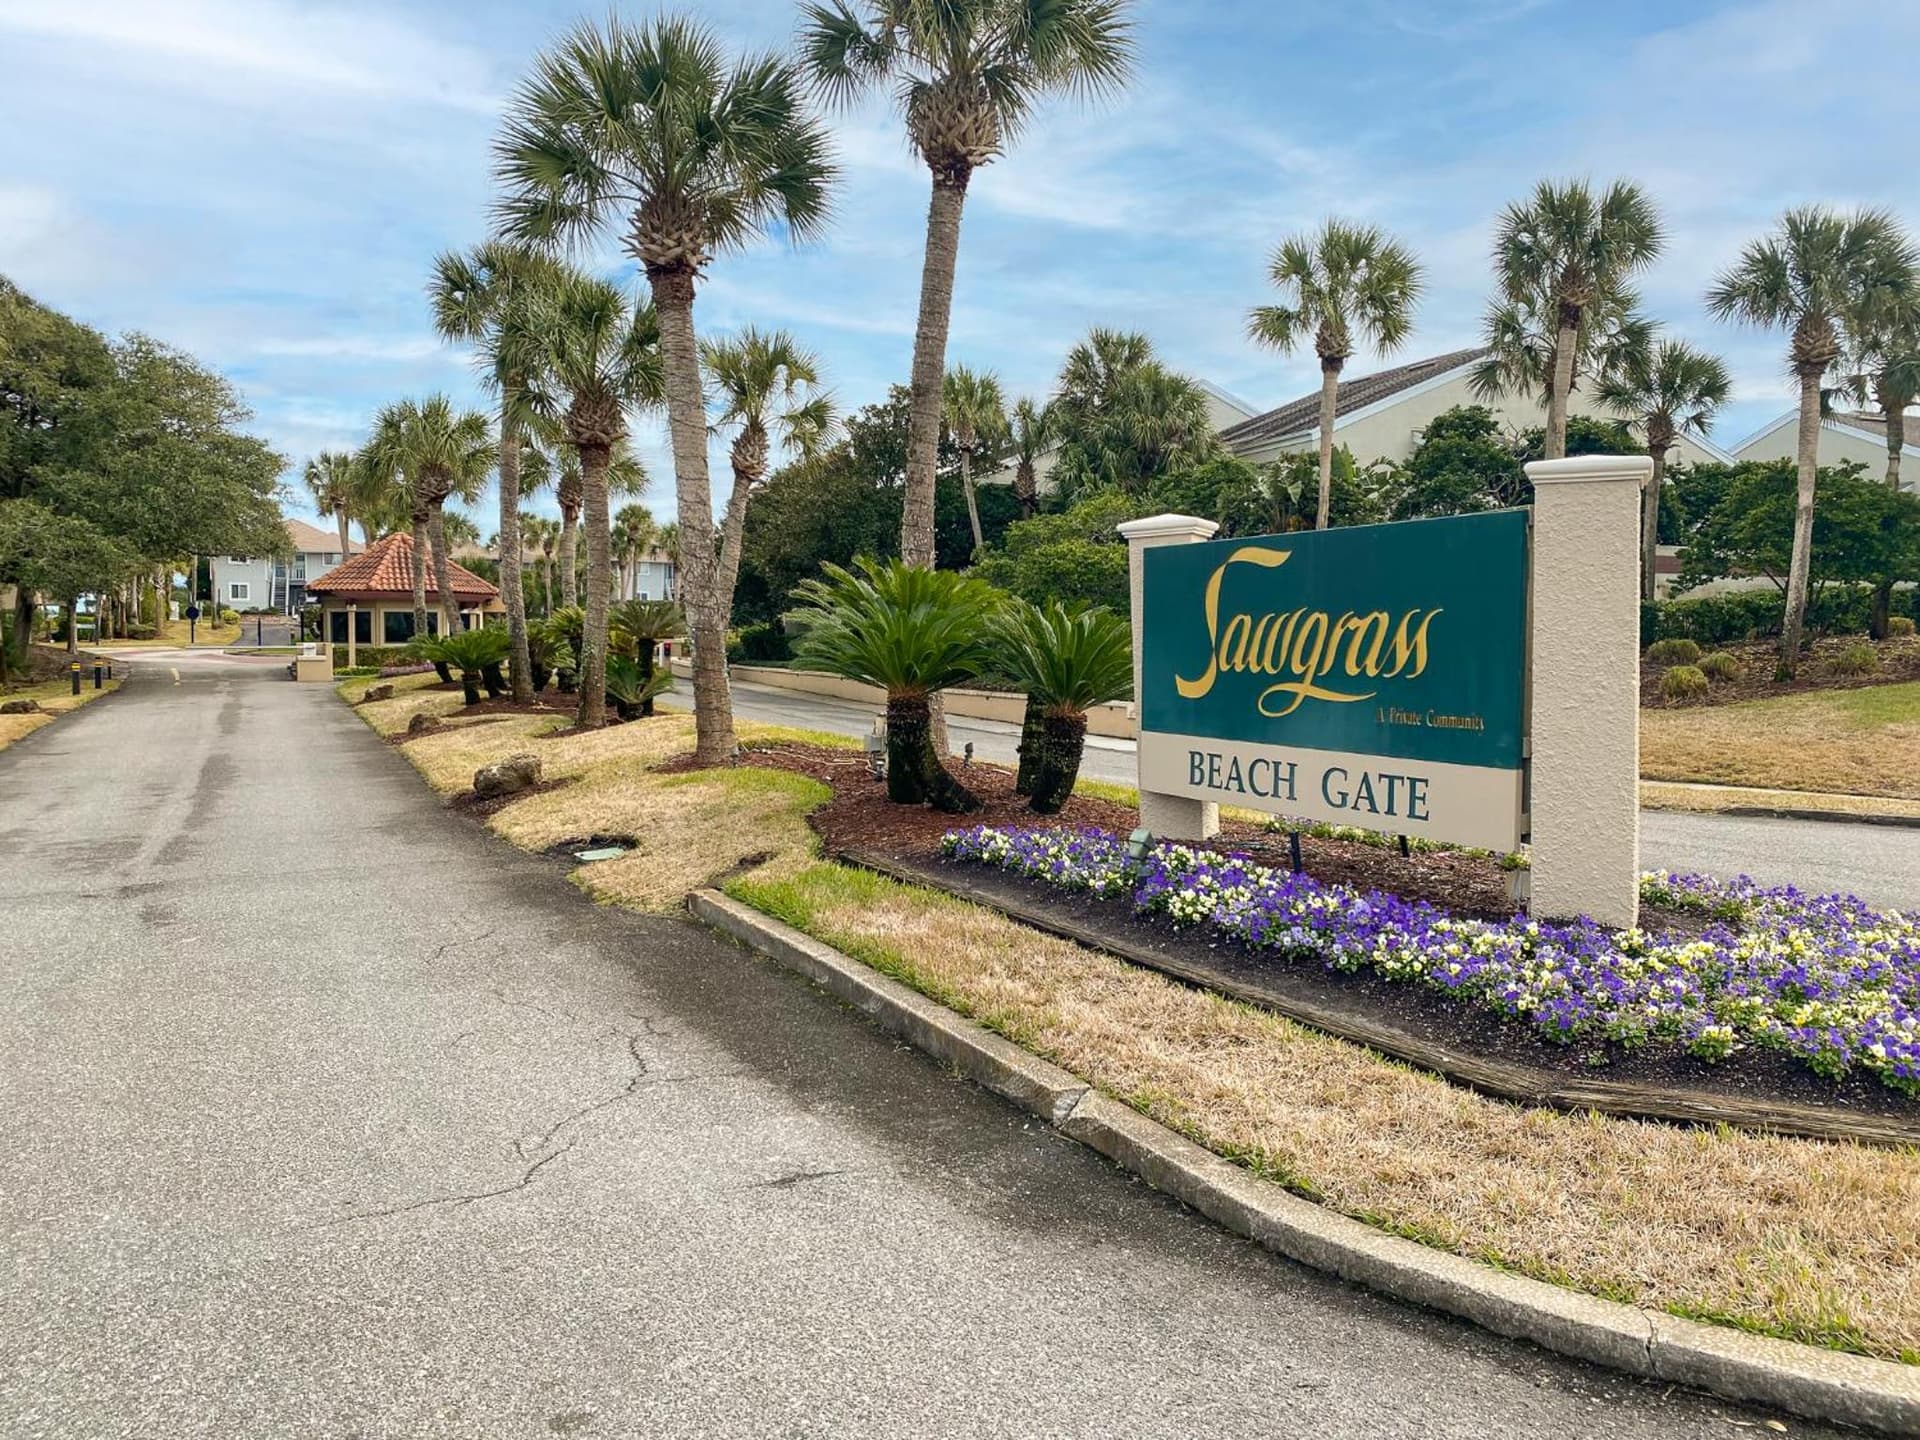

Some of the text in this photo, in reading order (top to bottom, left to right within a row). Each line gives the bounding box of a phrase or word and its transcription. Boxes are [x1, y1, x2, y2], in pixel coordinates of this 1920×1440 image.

[1175, 546, 1444, 717] Sawgrass
[1376, 706, 1484, 736] A Private Community
[1188, 750, 1430, 822] BEACH GATE
